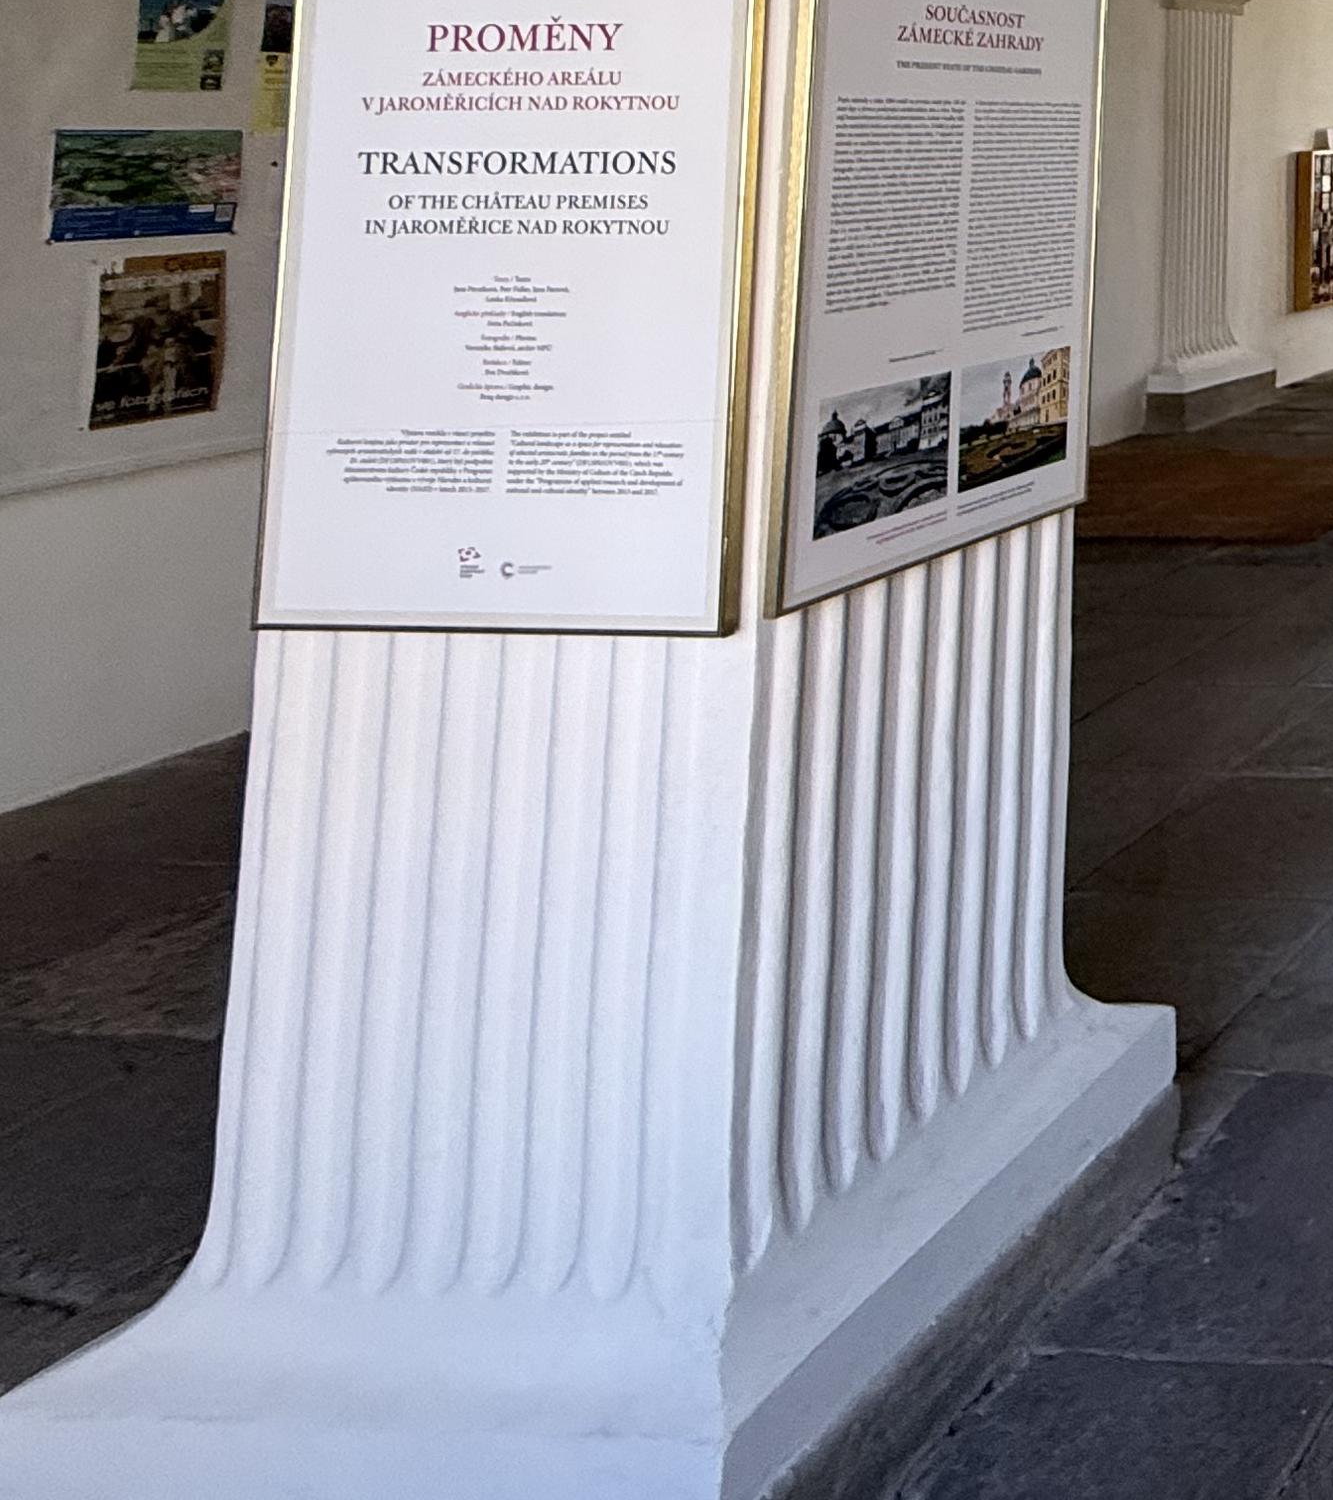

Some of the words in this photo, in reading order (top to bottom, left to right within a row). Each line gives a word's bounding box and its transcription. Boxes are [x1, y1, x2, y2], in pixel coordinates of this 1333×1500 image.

[925, 4, 1025, 28] SOUČASNOST
[426, 14, 624, 53] PROMĚNY
[897, 22, 974, 46] ZÁMECKÉ
[976, 32, 1044, 51] ZAHRADY
[421, 68, 544, 88] ZÁMECKÉHO
[547, 67, 623, 87] AREÁLU
[362, 96, 375, 111] V
[375, 91, 522, 114] JAROMĚŘICÍCH
[527, 95, 569, 111] NAD
[572, 94, 681, 111] ROKYTNOU
[358, 150, 677, 176] TRANSFORMATIONS
[388, 194, 412, 211] OF
[412, 194, 458, 210] THE
[461, 191, 552, 210] CHÂTEAU
[556, 193, 649, 210] PREMISES
[364, 219, 387, 236] IN
[388, 215, 513, 239] JAROMĚŘICE
[517, 218, 558, 235] NAD
[561, 218, 670, 235] ROKYTNOU
